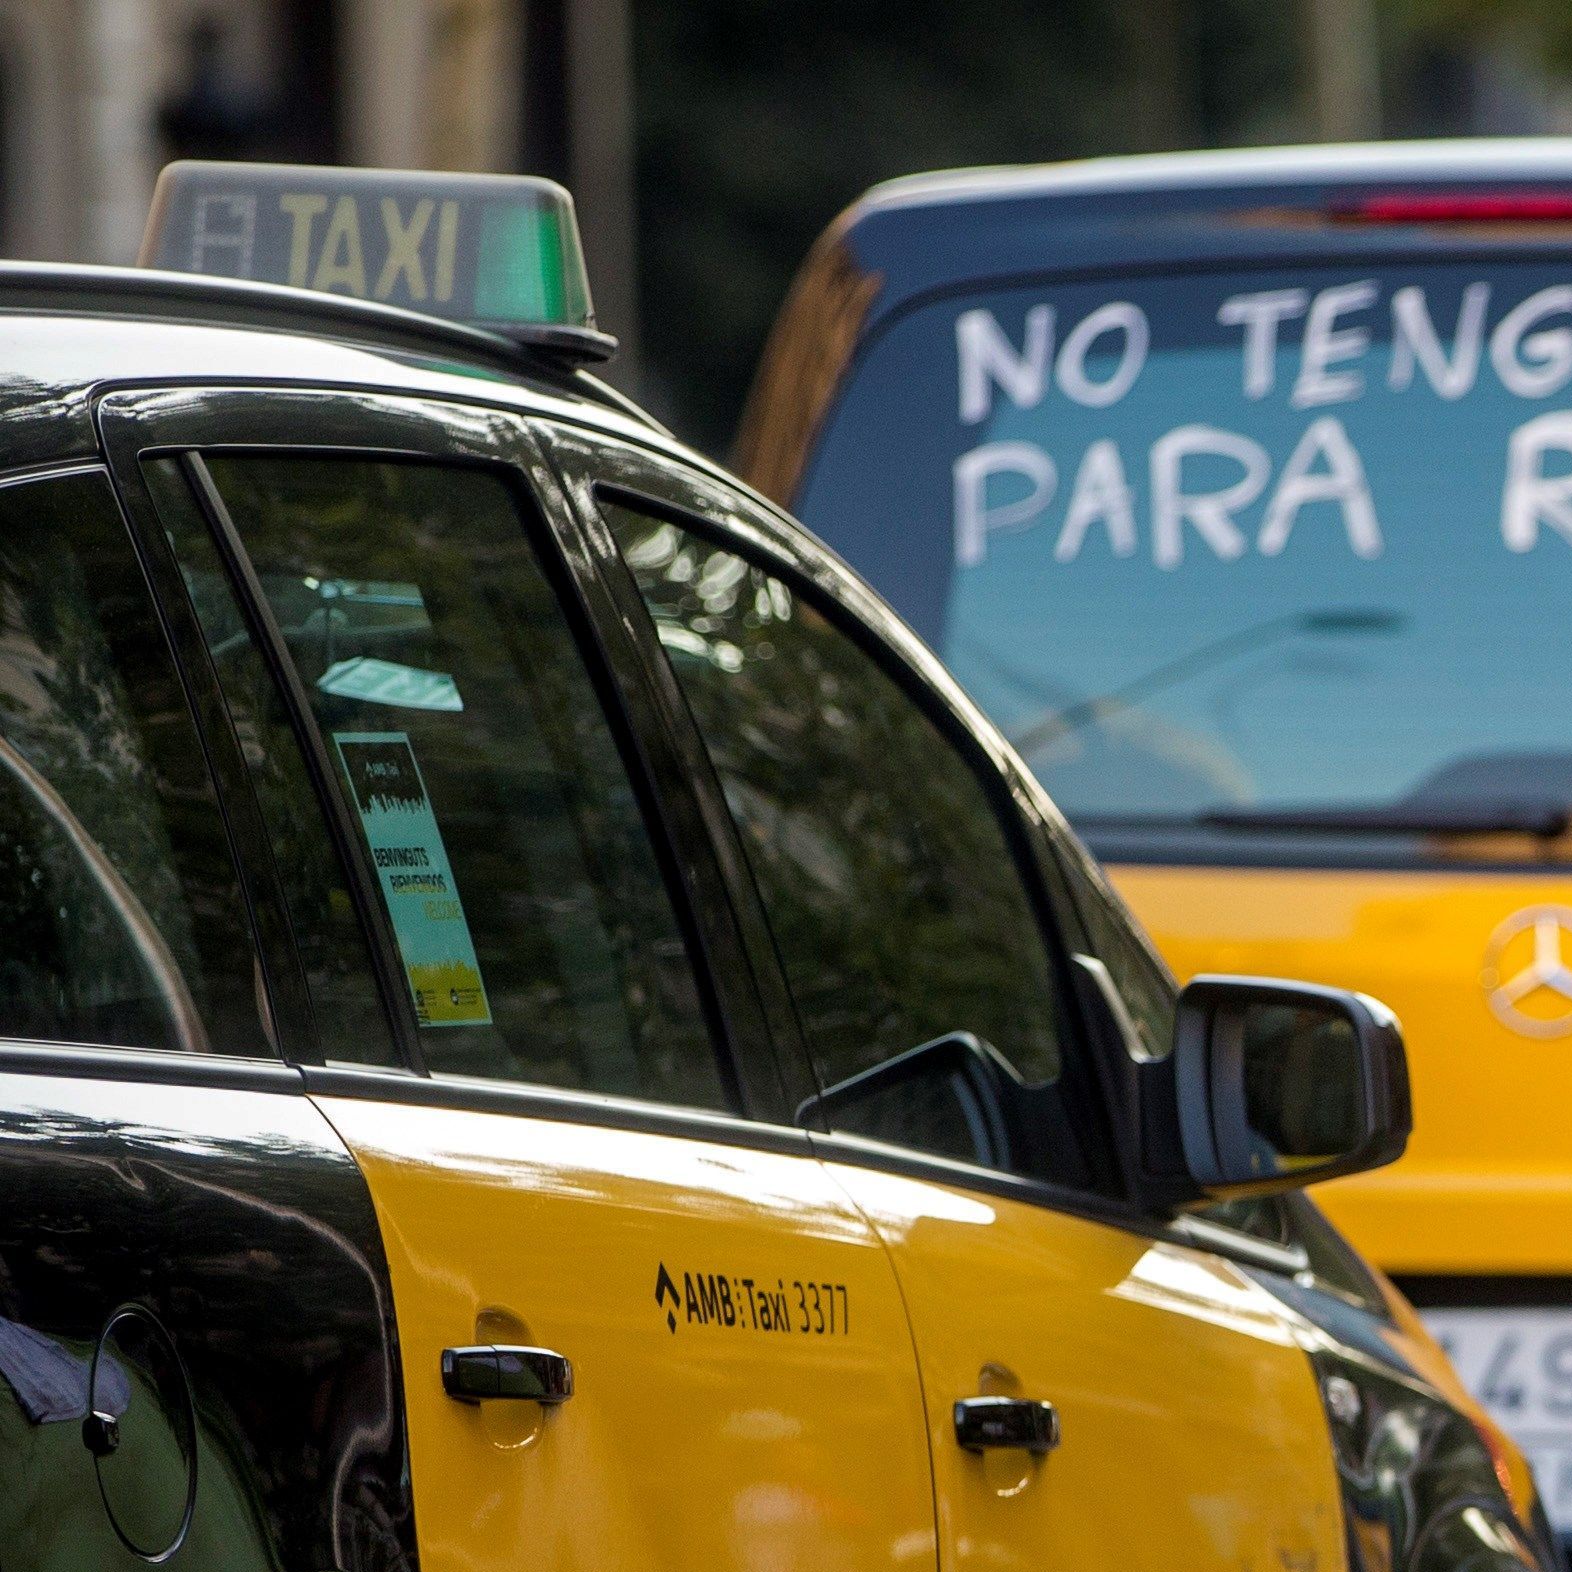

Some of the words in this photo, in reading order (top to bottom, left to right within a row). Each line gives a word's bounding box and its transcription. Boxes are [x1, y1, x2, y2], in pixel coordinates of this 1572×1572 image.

[279, 195, 461, 302] TAXI
[953, 300, 1152, 424] NO
[951, 415, 1386, 572] PARA
[373, 847, 430, 868] BENVINGUTS
[793, 1280, 849, 1336] 3377
